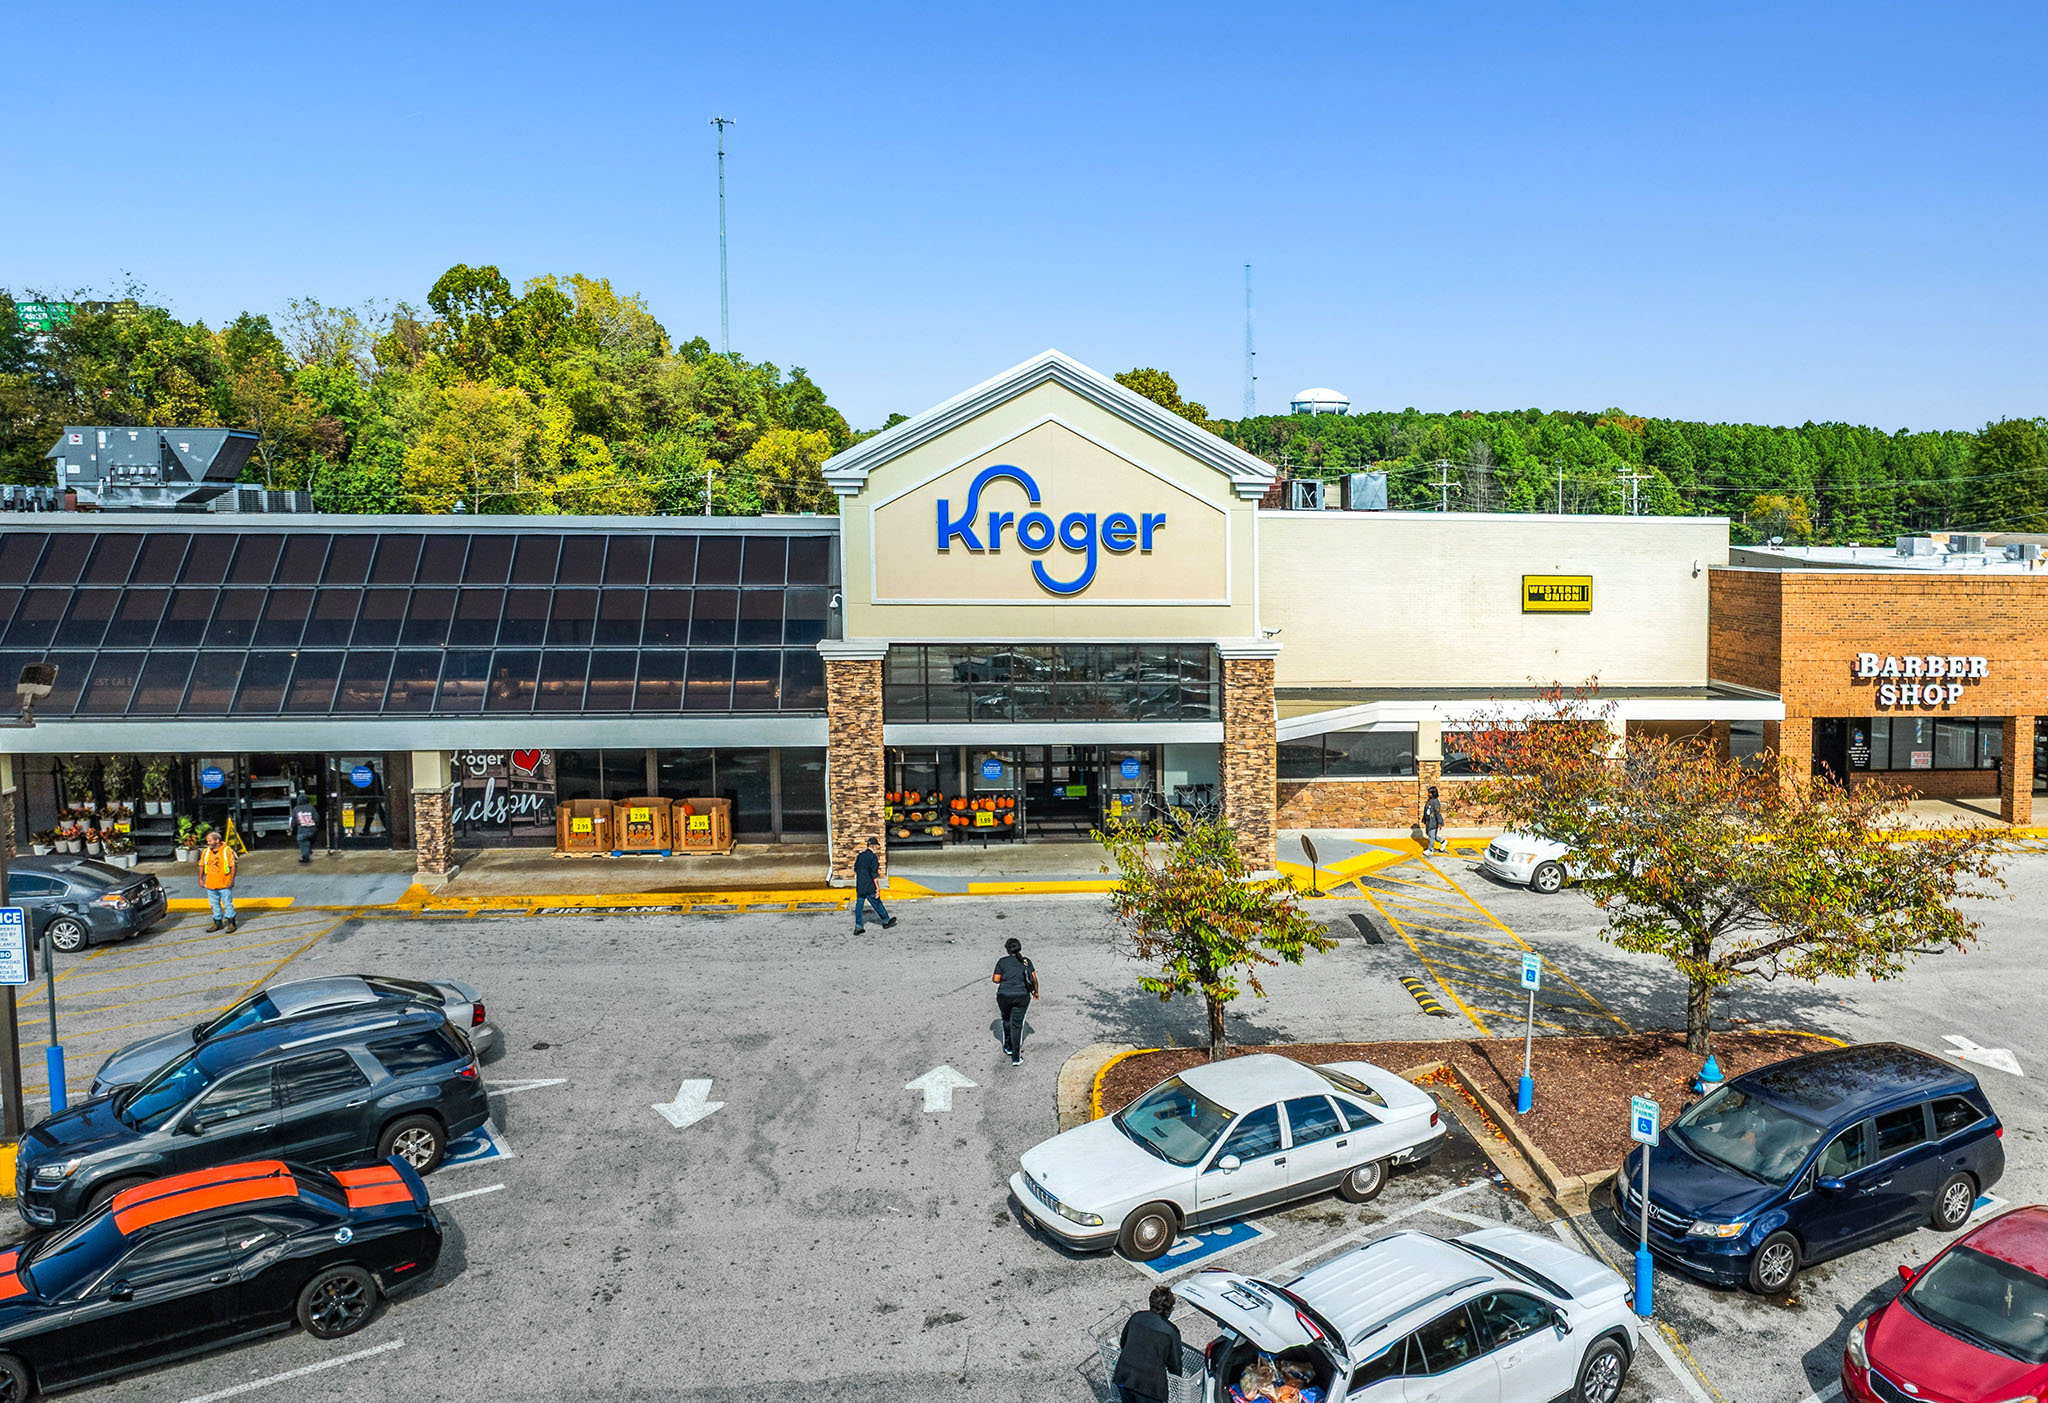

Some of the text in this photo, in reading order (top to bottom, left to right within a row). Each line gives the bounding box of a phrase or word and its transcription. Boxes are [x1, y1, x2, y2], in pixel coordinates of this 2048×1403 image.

[936, 464, 1166, 594] Kroger
[1528, 585, 1579, 594] WESTERN
[1544, 593, 1579, 601] UNION
[1857, 652, 1990, 678] BARBER
[1879, 683, 1965, 706] SHOP
[449, 749, 504, 775] Kroger
